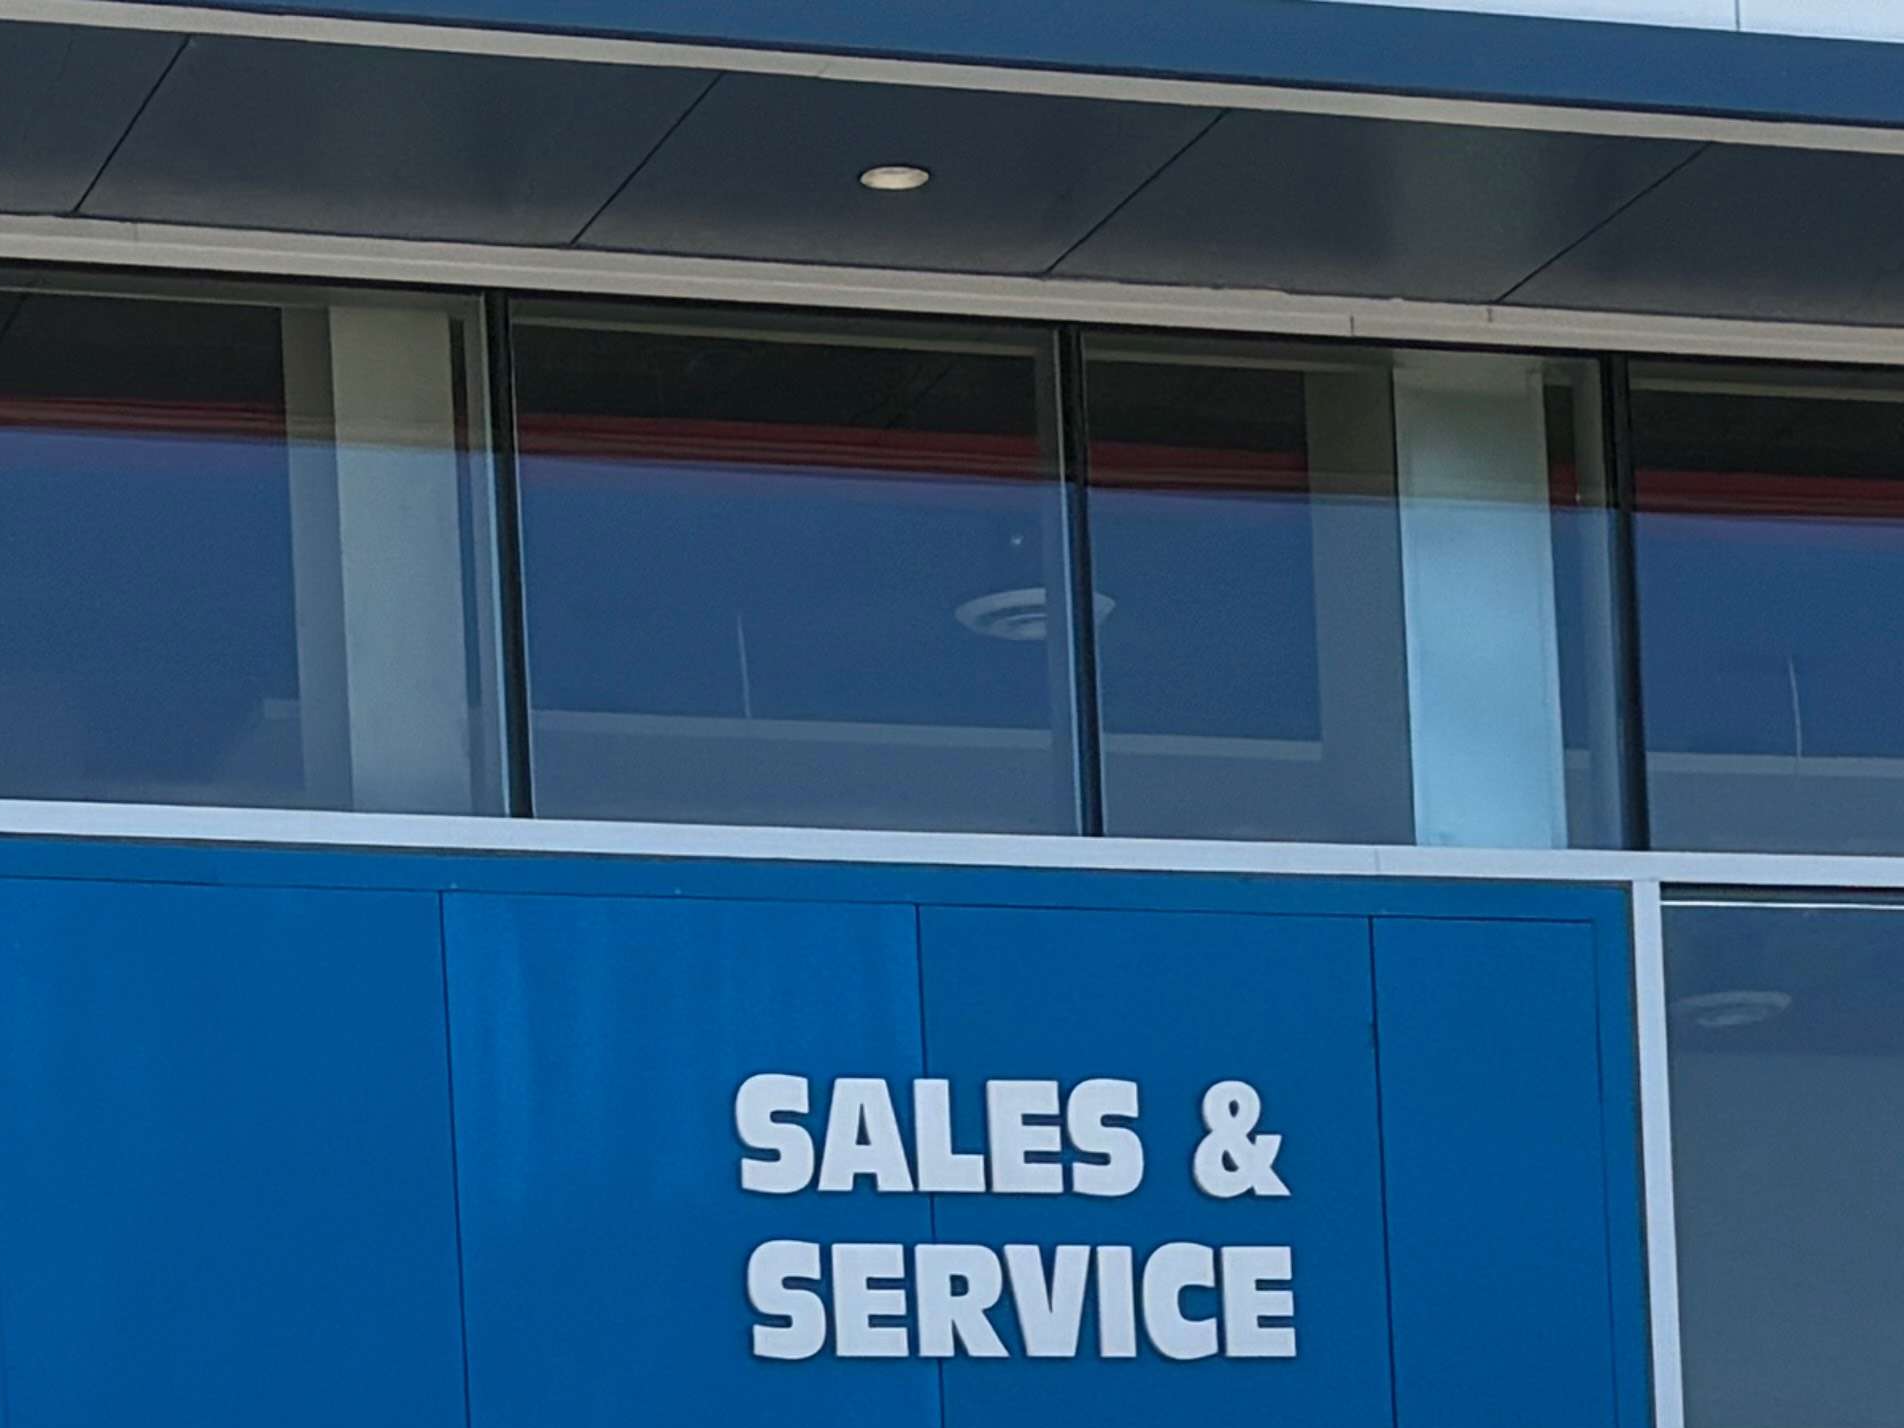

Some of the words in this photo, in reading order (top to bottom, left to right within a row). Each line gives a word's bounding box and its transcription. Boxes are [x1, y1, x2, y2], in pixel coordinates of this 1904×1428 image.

[735, 1073, 1144, 1197] SALES
[1193, 1079, 1291, 1199] &
[746, 1239, 1297, 1360] SERVICE
